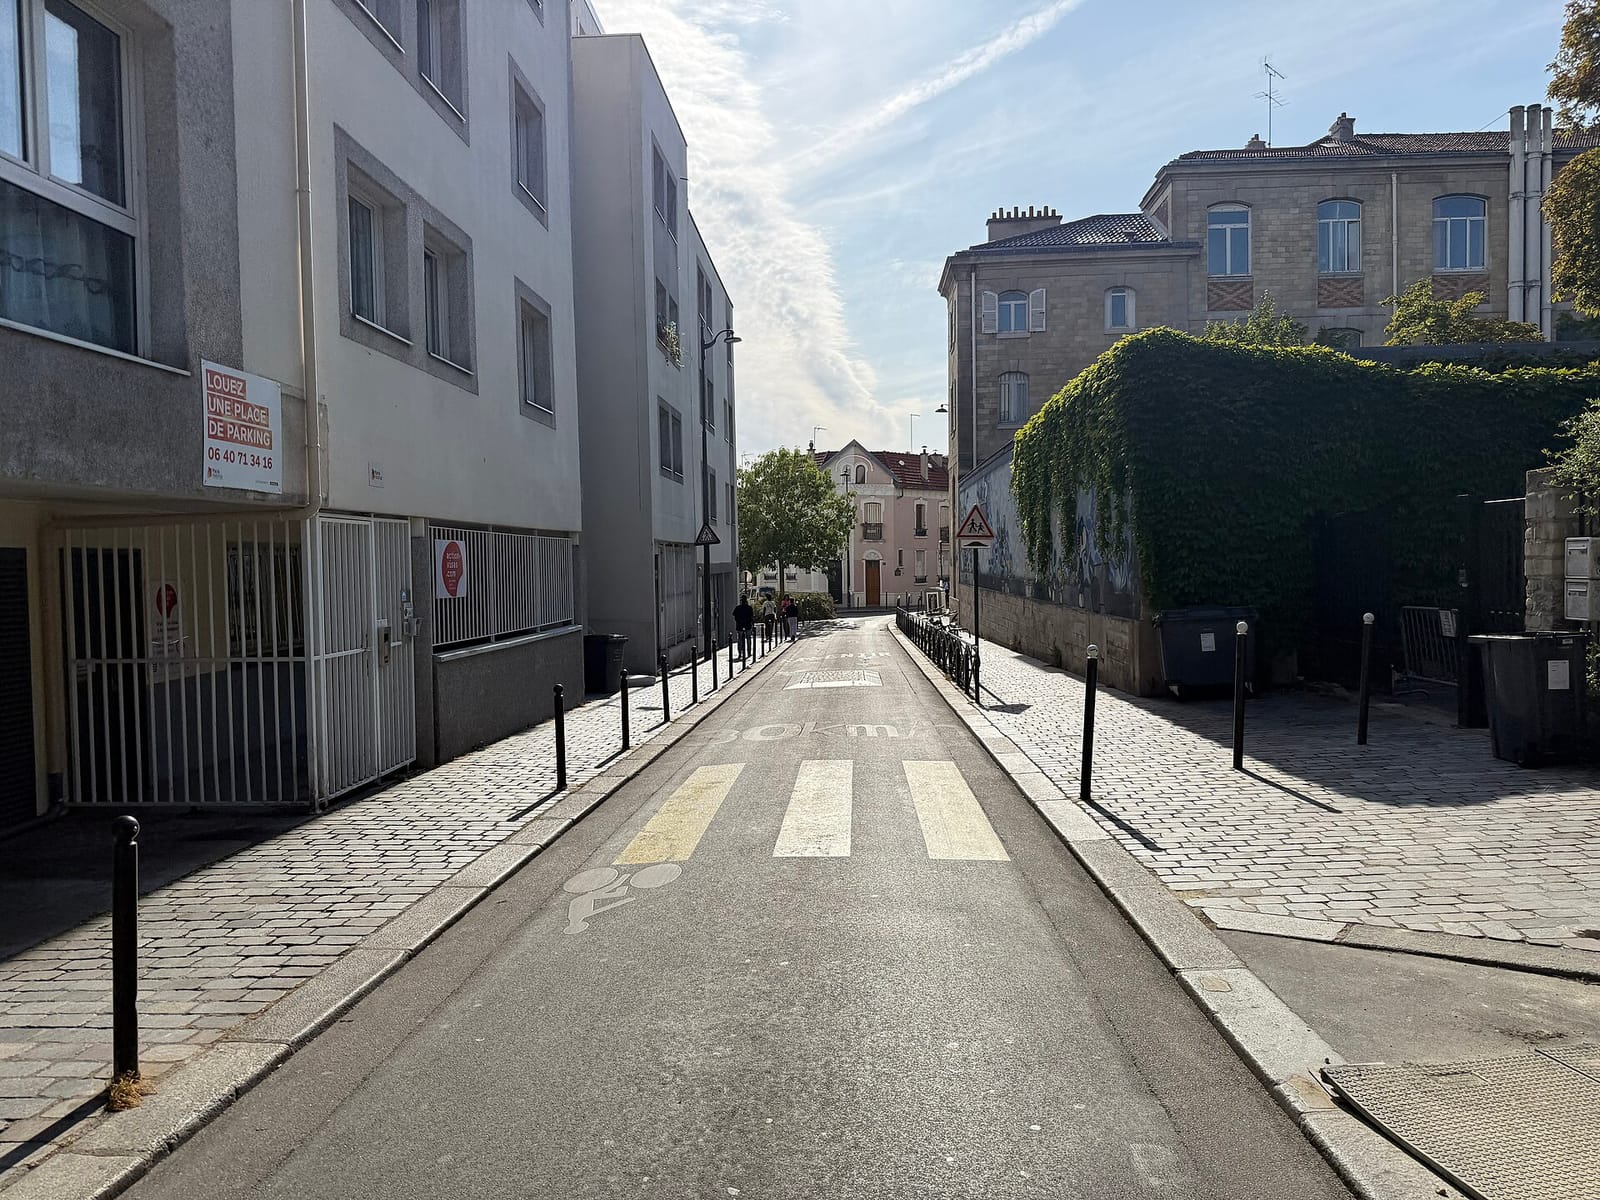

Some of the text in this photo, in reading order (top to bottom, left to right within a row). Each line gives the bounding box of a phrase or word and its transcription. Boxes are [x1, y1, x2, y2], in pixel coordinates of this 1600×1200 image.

[207, 372, 245, 396] LOUEZ
[207, 395, 267, 424] UNE PLACE
[208, 420, 271, 446] DE PARKING
[207, 446, 273, 470] 06 40 71 34 16
